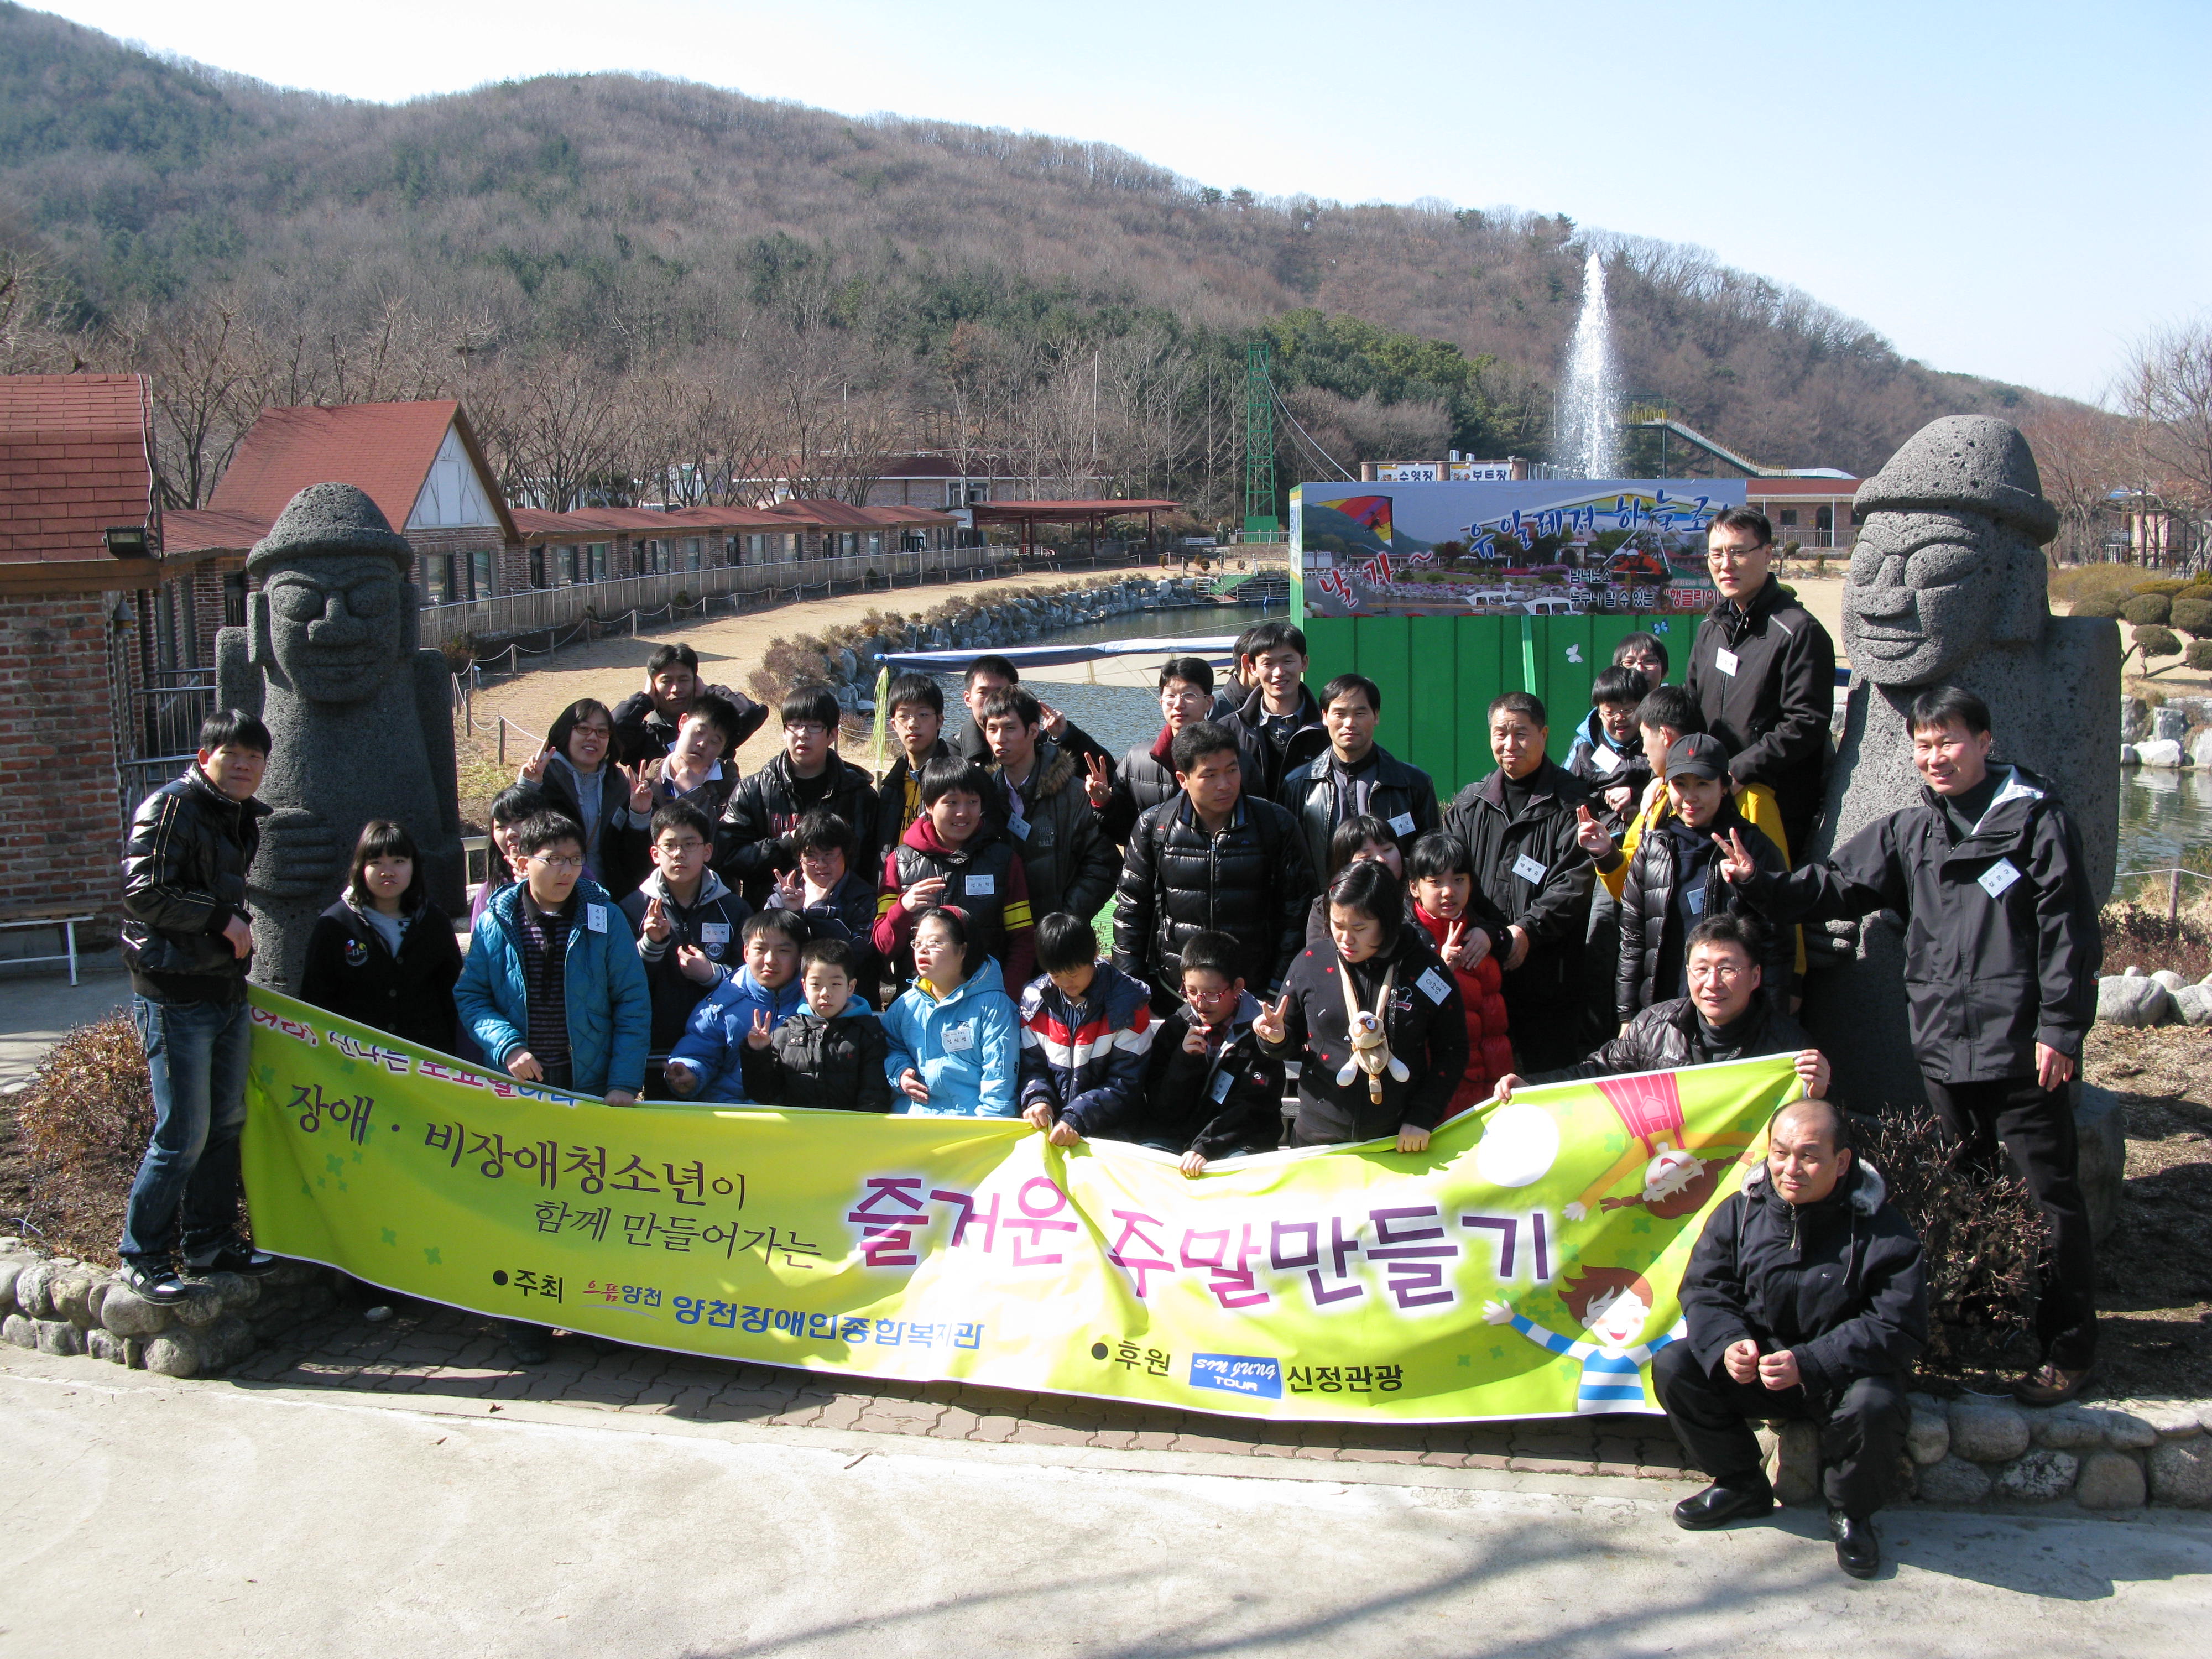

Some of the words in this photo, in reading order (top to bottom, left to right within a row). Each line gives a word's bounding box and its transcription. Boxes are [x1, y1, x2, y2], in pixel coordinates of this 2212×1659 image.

[1399, 470, 1434, 482] 수영장
[1473, 469, 1507, 481] 보트장
[1615, 488, 1728, 532] 하늘로
[1569, 568, 1613, 584] 남녀노소
[1570, 591, 1601, 607] 누구나
[1605, 592, 1616, 607] 탈
[1619, 592, 1629, 607] 수
[1633, 592, 1655, 607] 있는
[329, 1031, 409, 1072] 신나는
[1664, 1050, 1679, 1060] FILA
[287, 1084, 375, 1146] 장애
[425, 1121, 747, 1211] 비장애청소년이
[534, 1199, 612, 1243] 함께
[623, 1212, 822, 1269] 만들어가는
[848, 1176, 1078, 1267] 즐거운
[514, 1269, 563, 1304] 주최
[672, 1296, 985, 1350] 양천장애인종합복지관
[1114, 1340, 1171, 1377] 후원
[1213, 1375, 1258, 1392] TOUR
[1286, 1364, 1404, 1393] 신정관광
